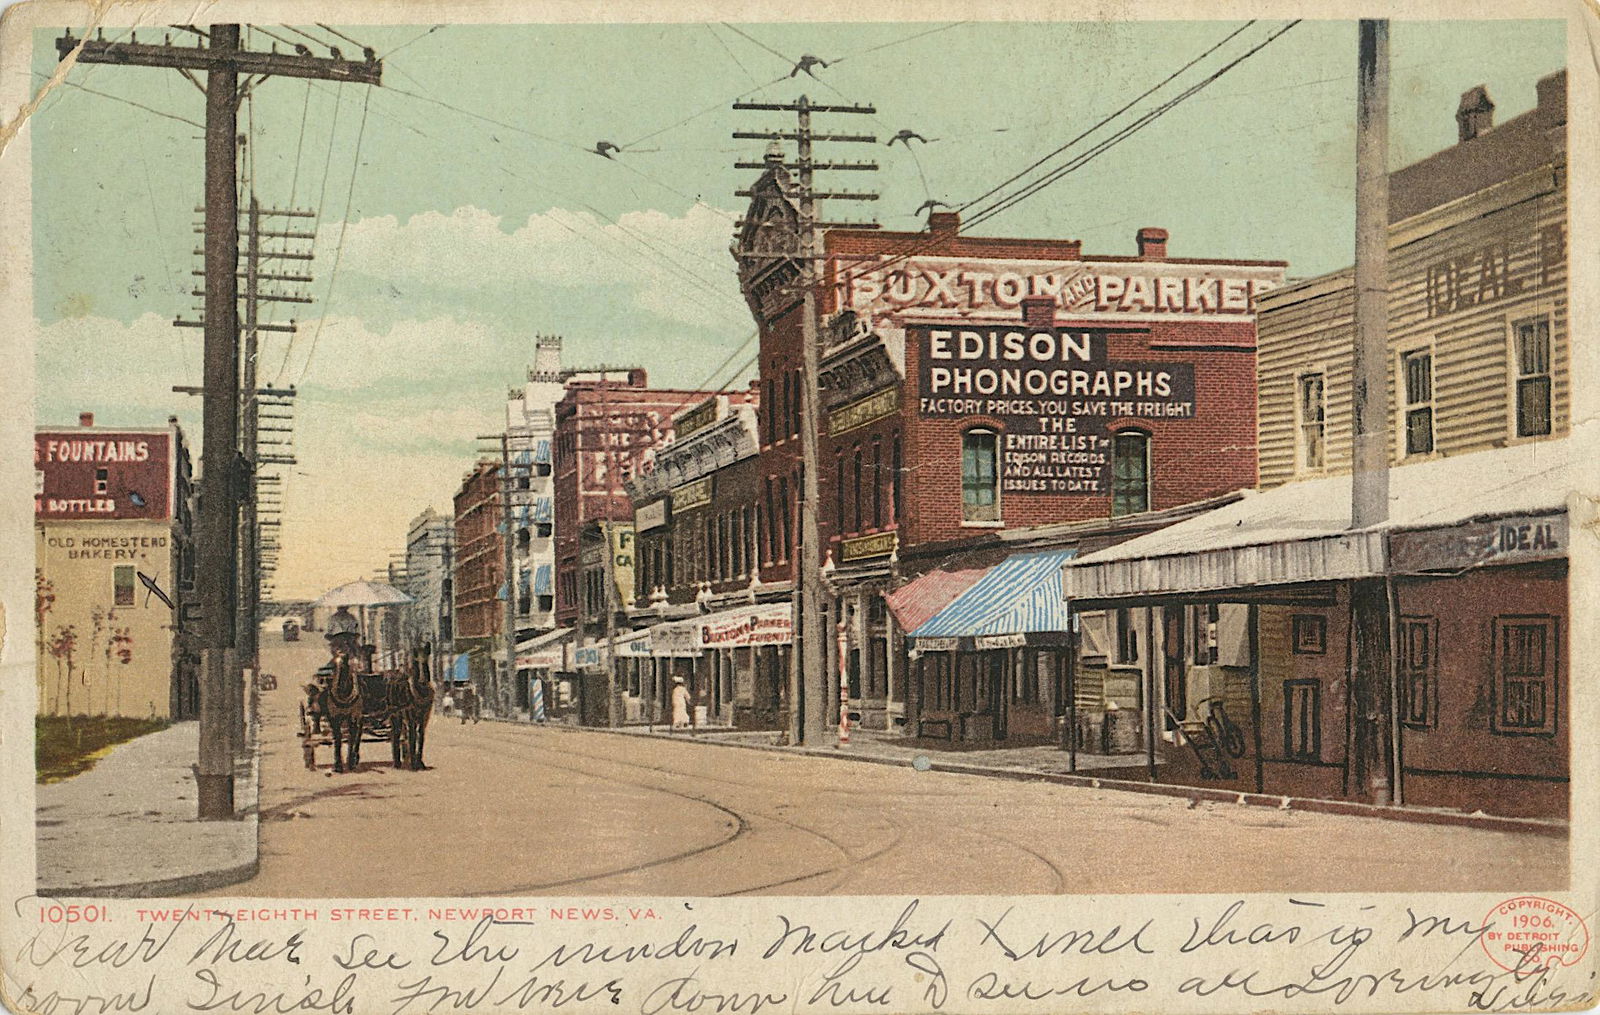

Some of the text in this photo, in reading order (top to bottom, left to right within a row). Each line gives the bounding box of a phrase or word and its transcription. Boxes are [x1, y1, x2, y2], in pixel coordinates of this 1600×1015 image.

[930, 331, 1091, 361] EDISON
[930, 367, 1172, 397] PHONOGRAPHS
[920, 398, 981, 414] FACTORY
[1039, 401, 1067, 416] YOU
[1072, 401, 1107, 416] SAVE
[1110, 402, 1134, 416] THE
[1136, 402, 1192, 417] FREIGHT
[1038, 417, 1076, 432] THE
[1005, 434, 1058, 450] ENTIRE
[1061, 435, 1098, 450] LIST
[47, 440, 149, 462] FOUNTAINS
[1004, 451, 1046, 463] EDISON
[1004, 466, 1102, 478] AND ALL LATEST
[1004, 479, 1047, 491] ISSUES
[1052, 480, 1066, 491] TO
[48, 499, 116, 512] BOTTLES
[47, 537, 75, 548] OLD
[1499, 523, 1559, 552] IDEAL
